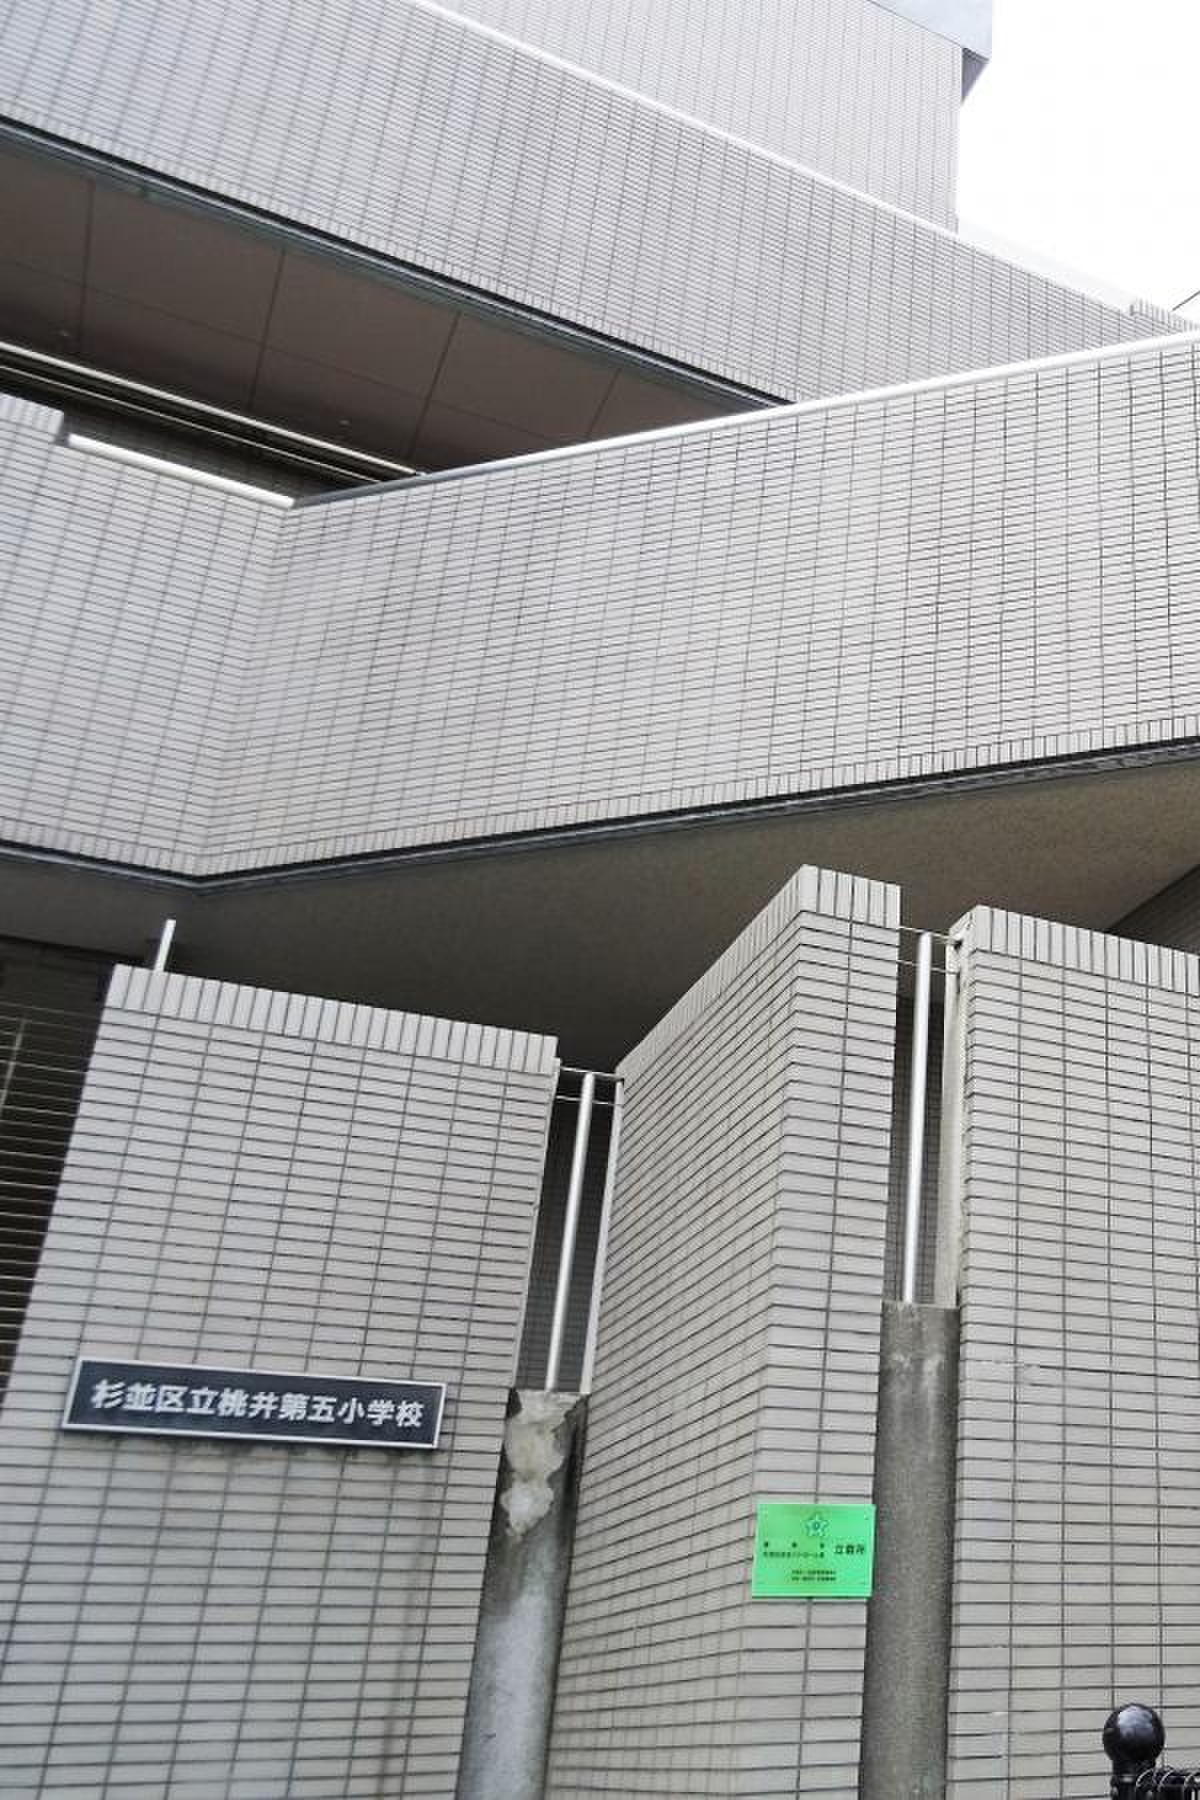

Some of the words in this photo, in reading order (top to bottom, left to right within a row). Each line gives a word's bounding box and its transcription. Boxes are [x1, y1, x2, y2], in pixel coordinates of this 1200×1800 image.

[91, 1380, 425, 1428] 杉並区立桃井第五小学校
